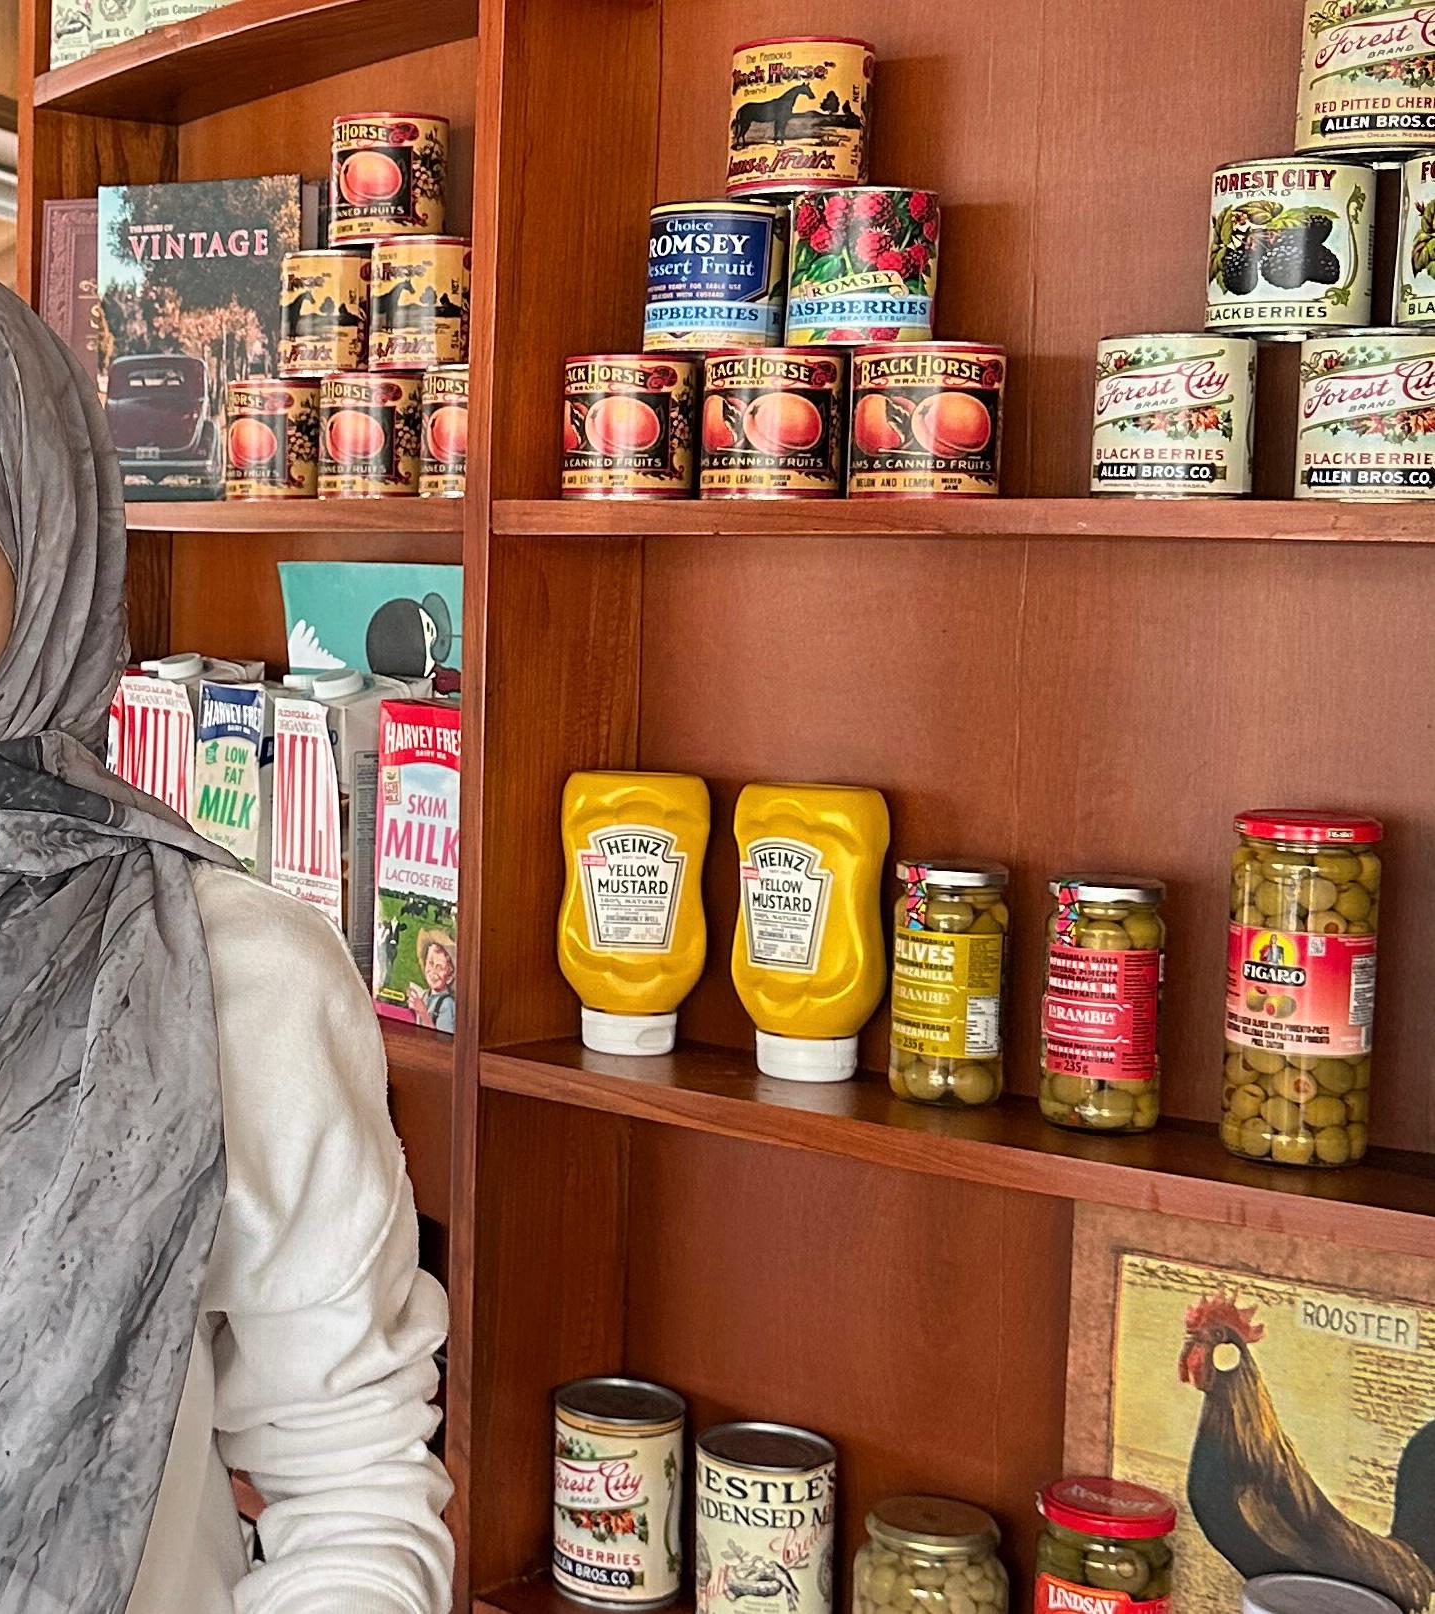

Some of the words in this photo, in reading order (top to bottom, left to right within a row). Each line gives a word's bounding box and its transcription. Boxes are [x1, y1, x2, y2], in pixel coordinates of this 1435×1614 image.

[1315, 19, 1413, 69] Forest
[1367, 44, 1414, 59] BRAND
[759, 50, 793, 62] Famous
[766, 62, 827, 85] Horse
[1314, 101, 1337, 114] RED
[1341, 97, 1391, 111] PITTED
[341, 123, 387, 141] HORSE
[1325, 116, 1370, 131] ALLEN
[1214, 170, 1279, 194] FOREST
[1282, 168, 1337, 190] CITY
[1235, 188, 1292, 199] BRAND
[363, 205, 405, 216] FRUITS
[666, 219, 714, 233] Choice
[128, 229, 268, 263] VINTAGE
[648, 233, 751, 259] ROMSEY
[648, 260, 692, 278] essert
[701, 256, 755, 277] Fruit
[690, 282, 702, 290] FOR
[728, 283, 742, 291] USE
[812, 272, 895, 297] ROMSEY
[790, 300, 927, 316] RASPBERRIES
[566, 368, 586, 382] ACK
[587, 363, 645, 385] HORSE
[707, 361, 745, 383] BLACK
[748, 357, 810, 382] HORSE
[861, 358, 913, 386] BLACK
[916, 355, 981, 381] HORSE
[1096, 373, 1177, 416] Forest
[1179, 361, 1230, 400] City
[1303, 374, 1394, 419] Forest
[1397, 360, 1435, 401] Cit
[234, 392, 264, 408] ORSE
[1134, 397, 1179, 410] BRAND
[1348, 399, 1396, 413] BRAND
[569, 458, 613, 468] CANNED
[615, 457, 662, 468] FRUITS
[722, 457, 775, 467] CANNED
[778, 457, 824, 467] FRUITS
[1096, 448, 1225, 461] BLACKBERRIES
[1304, 452, 1434, 465] BLACKBERRIE
[873, 460, 882, 469] &
[885, 459, 946, 469] CANNED
[950, 459, 991, 471] FRUITS
[1100, 465, 1136, 478] ALLEN
[880, 478, 898, 487] AND
[903, 478, 935, 488] LEMON
[1310, 470, 1351, 484] ALLEN
[202, 699, 241, 729] HARVEY
[384, 721, 433, 755] HARVEY
[224, 745, 248, 765] LOW
[223, 765, 245, 785] FAT
[197, 784, 256, 830] MILK
[407, 793, 447, 820] SKIM
[384, 818, 460, 869] MILK
[606, 838, 663, 857] HEINZ
[608, 864, 660, 878] YELLOW
[758, 852, 805, 872] HEINZ
[385, 866, 430, 888] LACTOSE
[432, 875, 454, 892] FREE
[597, 878, 669, 895] MUSTARD
[758, 878, 803, 894] YELLOW
[752, 892, 812, 913] MUSTARD
[1243, 963, 1305, 985] FIGARO
[1303, 1300, 1409, 1345] ROOSTER
[555, 1468, 596, 1494] orest
[600, 1461, 643, 1502] City
[704, 1465, 837, 1503] ESTLE'S
[701, 1498, 805, 1531] DENSED
[555, 1536, 641, 1566] ACKBERRIES
[1048, 1583, 1117, 1614] LINDSAY
